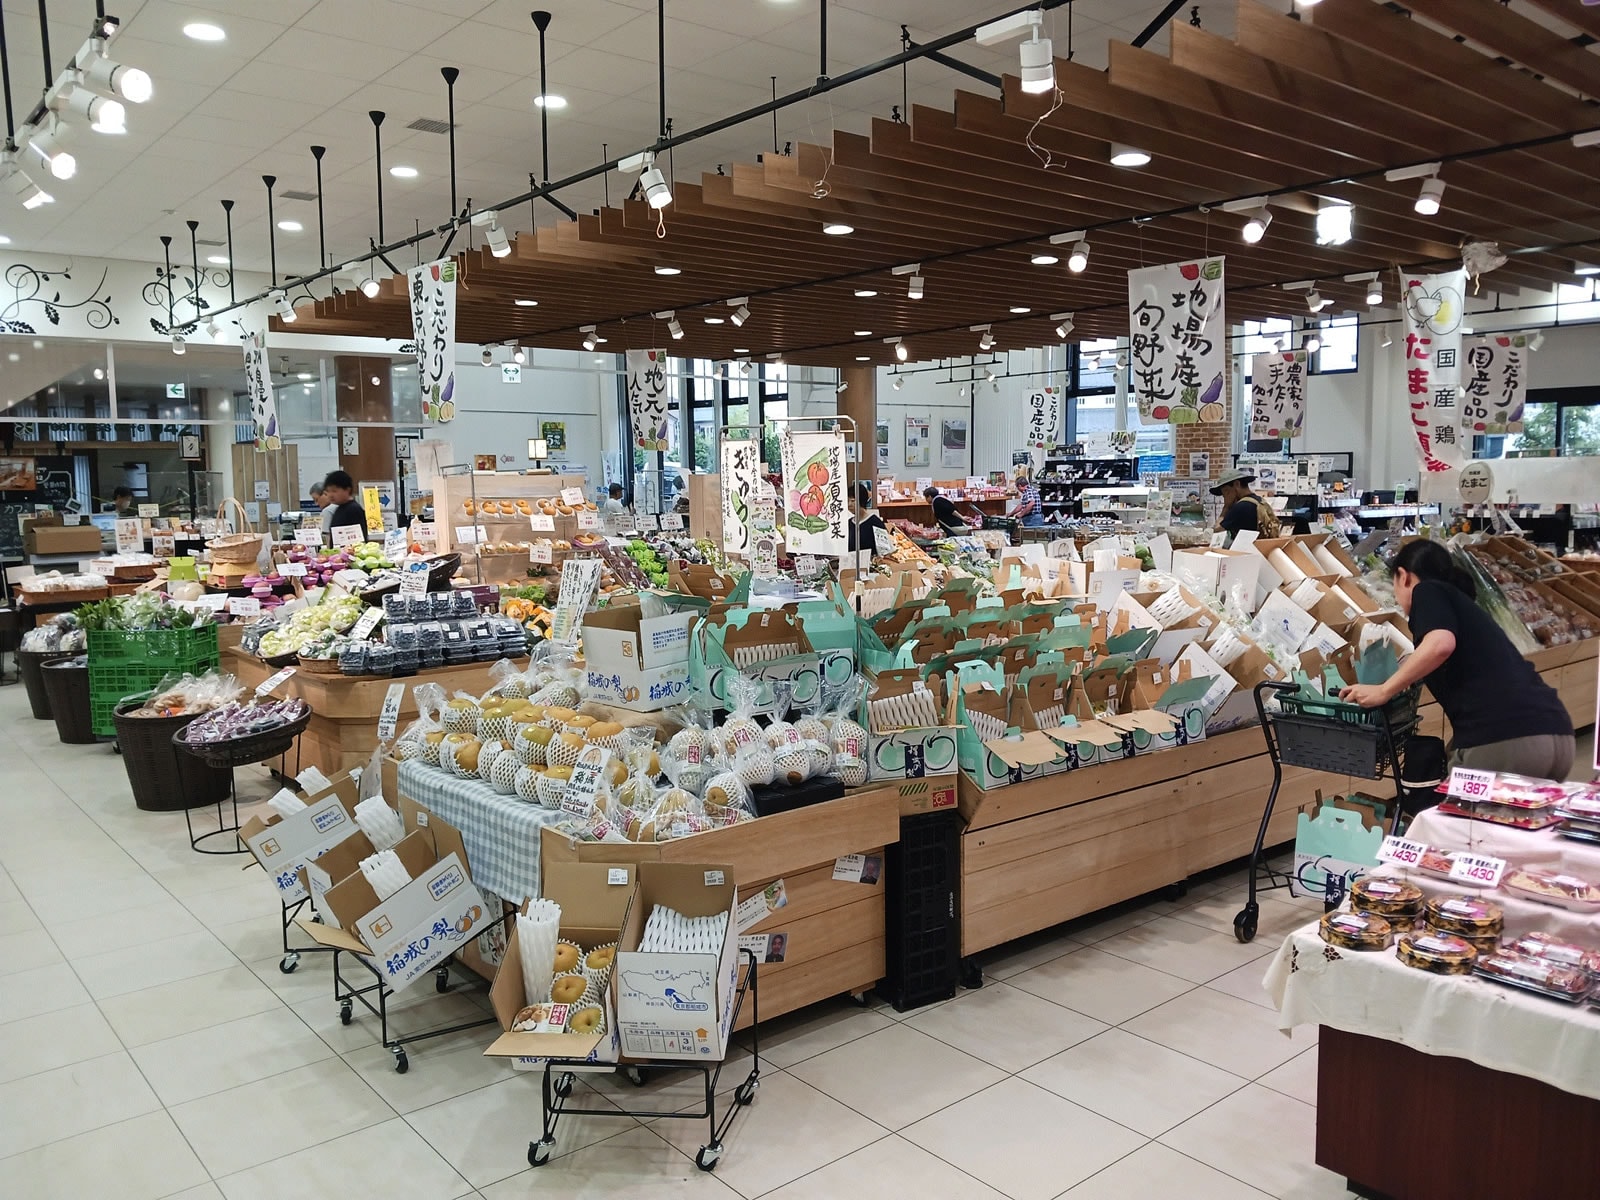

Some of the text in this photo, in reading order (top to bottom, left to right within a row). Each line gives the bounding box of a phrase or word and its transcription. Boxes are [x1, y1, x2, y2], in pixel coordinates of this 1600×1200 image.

[412, 272, 431, 396] 東京野菜
[430, 287, 448, 382] こだわり
[1132, 300, 1176, 403] 旬野菜
[1171, 280, 1222, 388] 地場産
[1494, 351, 1521, 407] こだわり
[644, 364, 665, 426] 地元で
[1433, 348, 1456, 445] 国産鶏
[1464, 346, 1494, 418] 国産品
[734, 449, 750, 550] きゅうり
[587, 672, 623, 692] 稲城の梨
[386, 917, 454, 976] 稲城の梨
